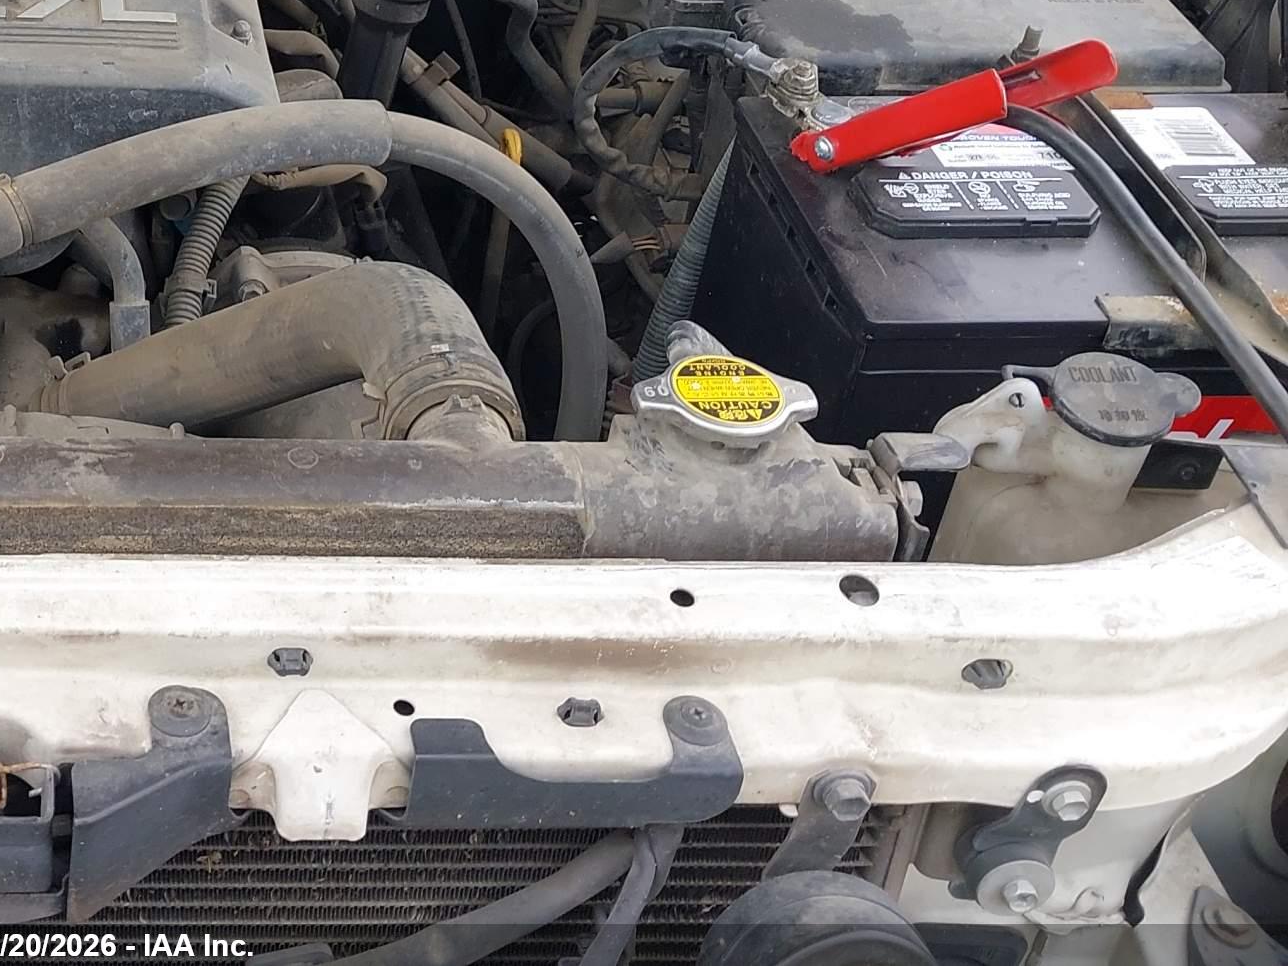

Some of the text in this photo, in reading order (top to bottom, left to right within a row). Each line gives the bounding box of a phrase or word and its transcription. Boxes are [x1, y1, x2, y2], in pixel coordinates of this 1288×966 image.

[912, 171, 969, 181] DANGER
[980, 170, 1033, 180] POISON
[1068, 366, 1137, 383] COOLANT
[698, 401, 772, 410] CAUTION
